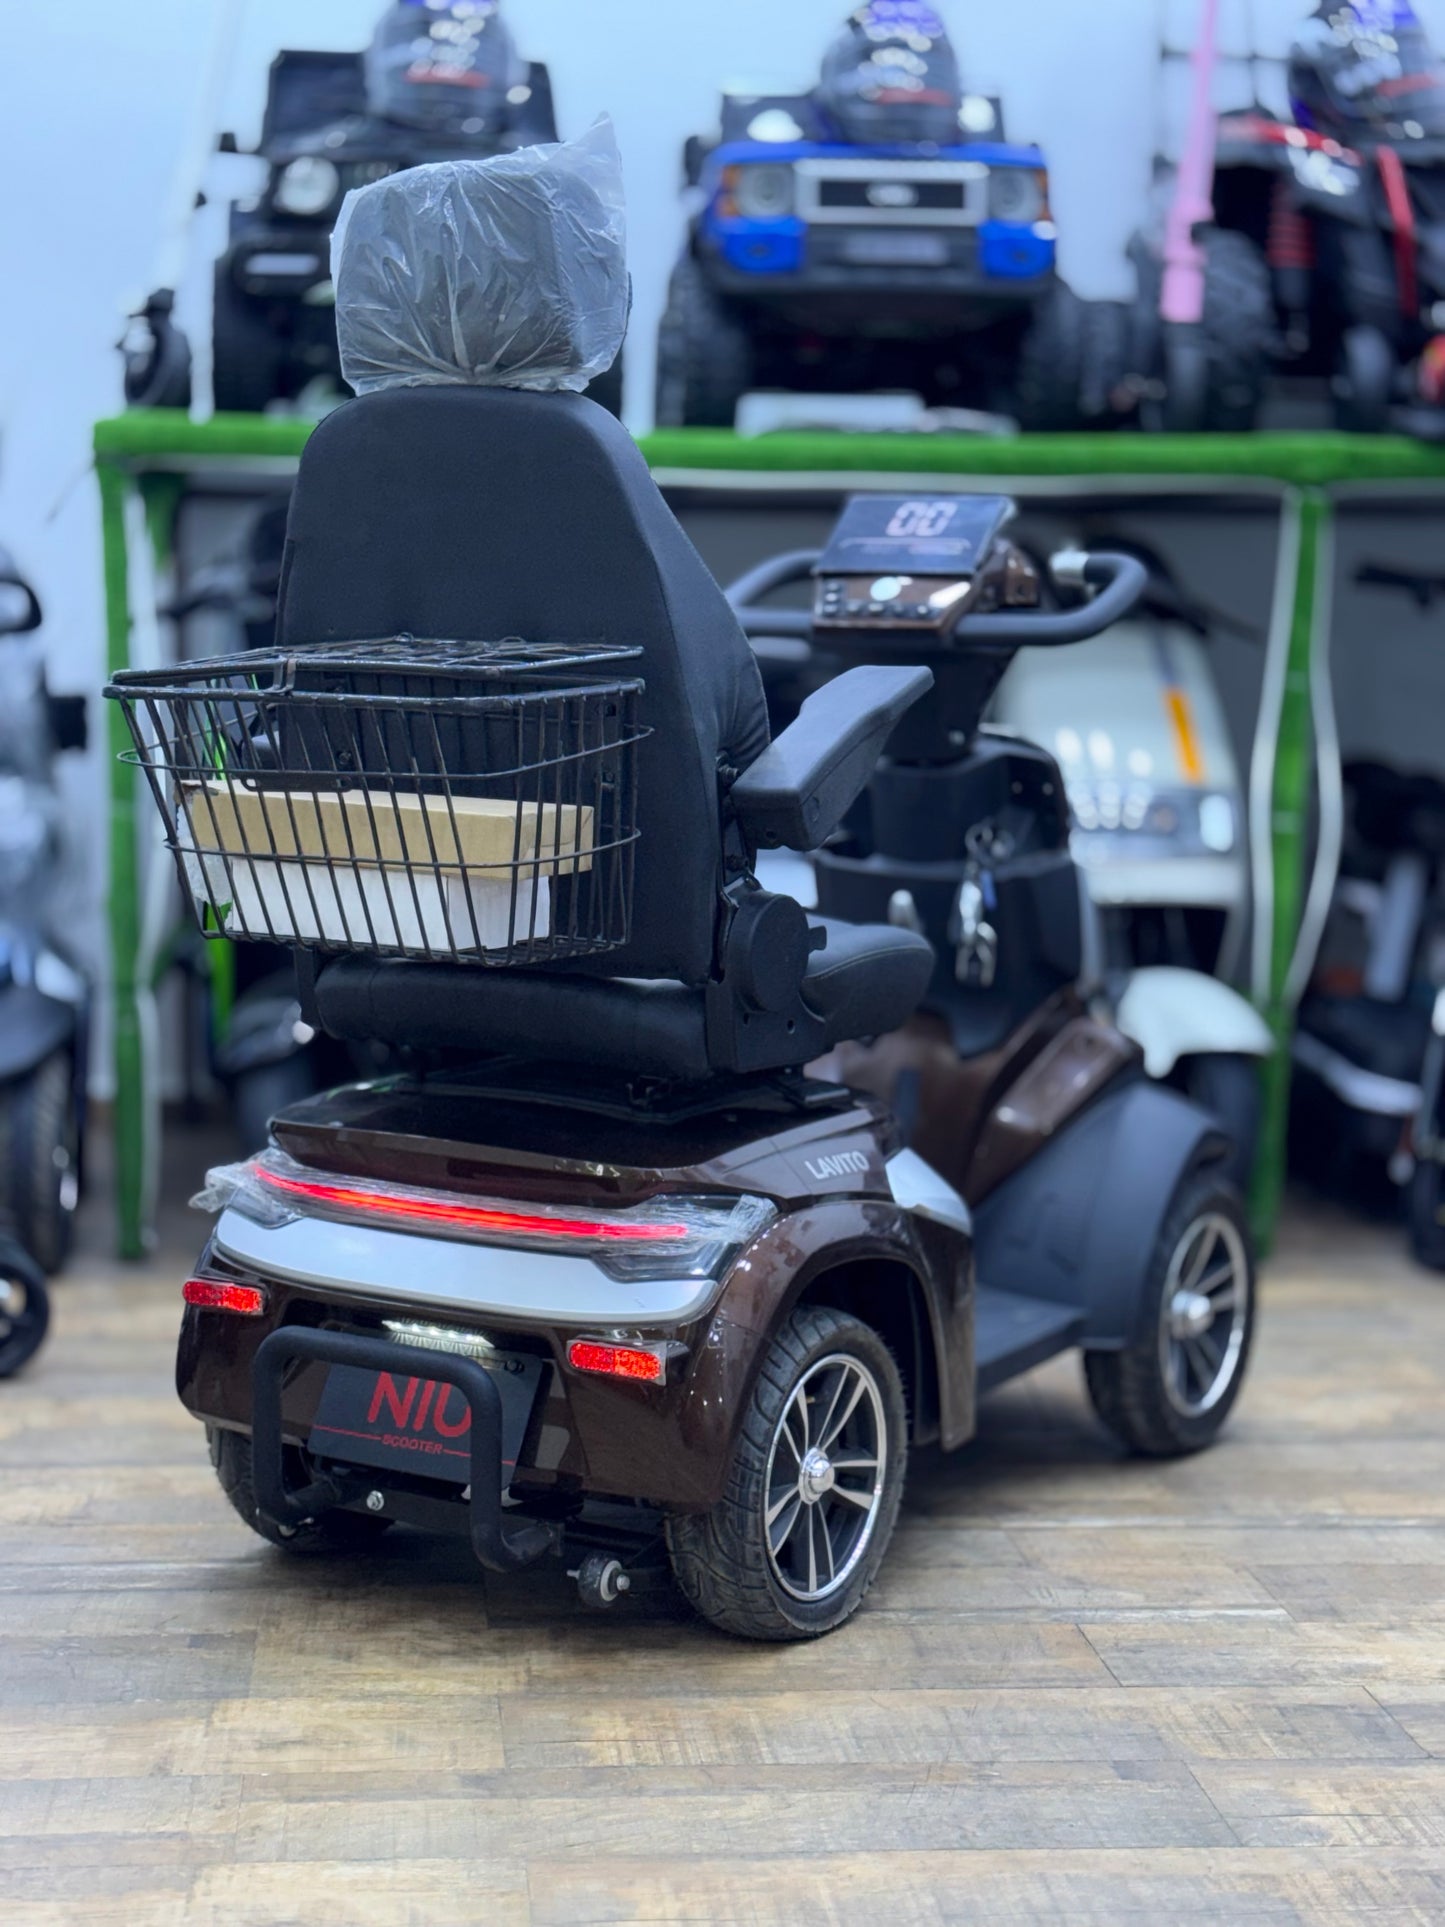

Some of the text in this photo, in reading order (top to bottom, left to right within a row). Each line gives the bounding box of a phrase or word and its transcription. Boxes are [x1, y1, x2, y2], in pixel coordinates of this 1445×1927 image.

[885, 502, 958, 536] 00
[804, 1150, 870, 1180] LAVITO
[382, 1434, 443, 1454] SCOOTER
